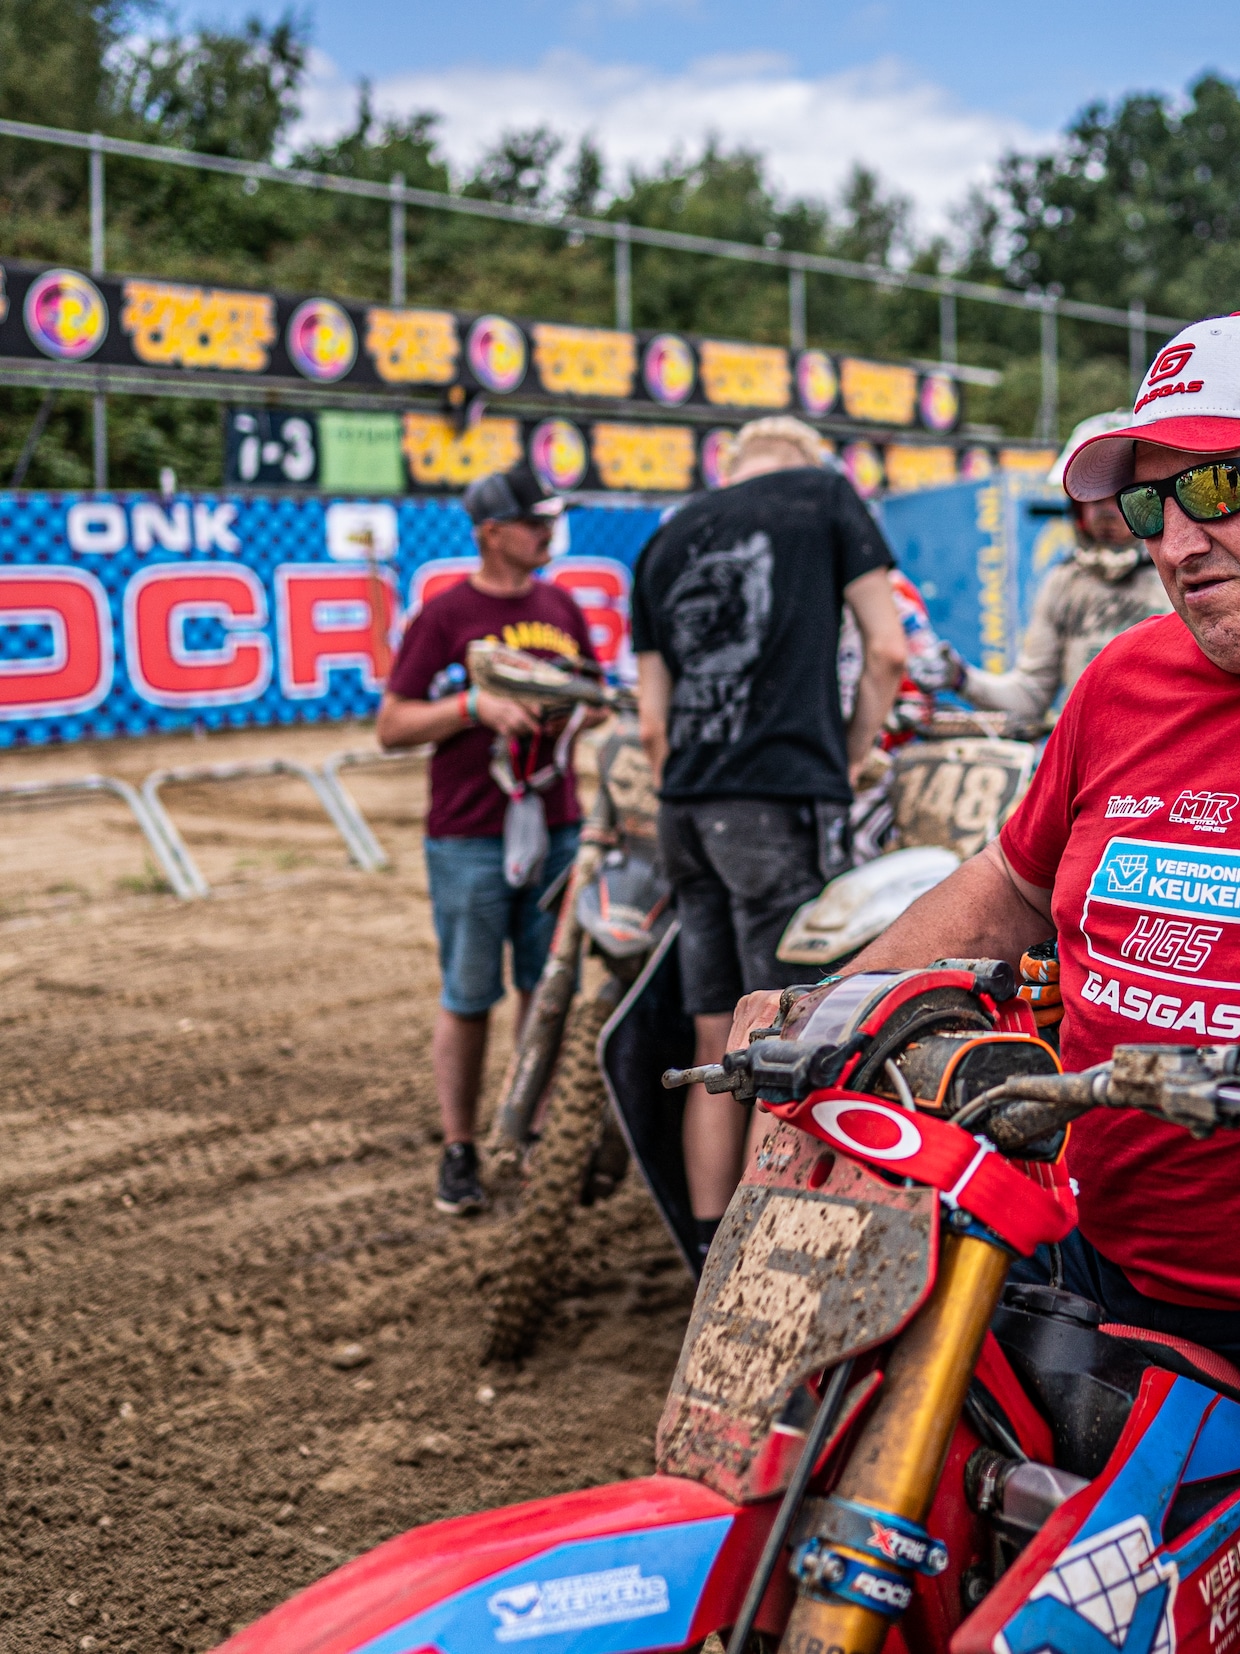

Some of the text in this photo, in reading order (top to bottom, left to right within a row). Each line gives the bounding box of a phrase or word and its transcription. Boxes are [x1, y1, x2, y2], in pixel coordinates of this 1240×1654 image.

[66, 502, 243, 555] ONK
[896, 763, 1008, 833] 148
[1120, 915, 1223, 973] HGS
